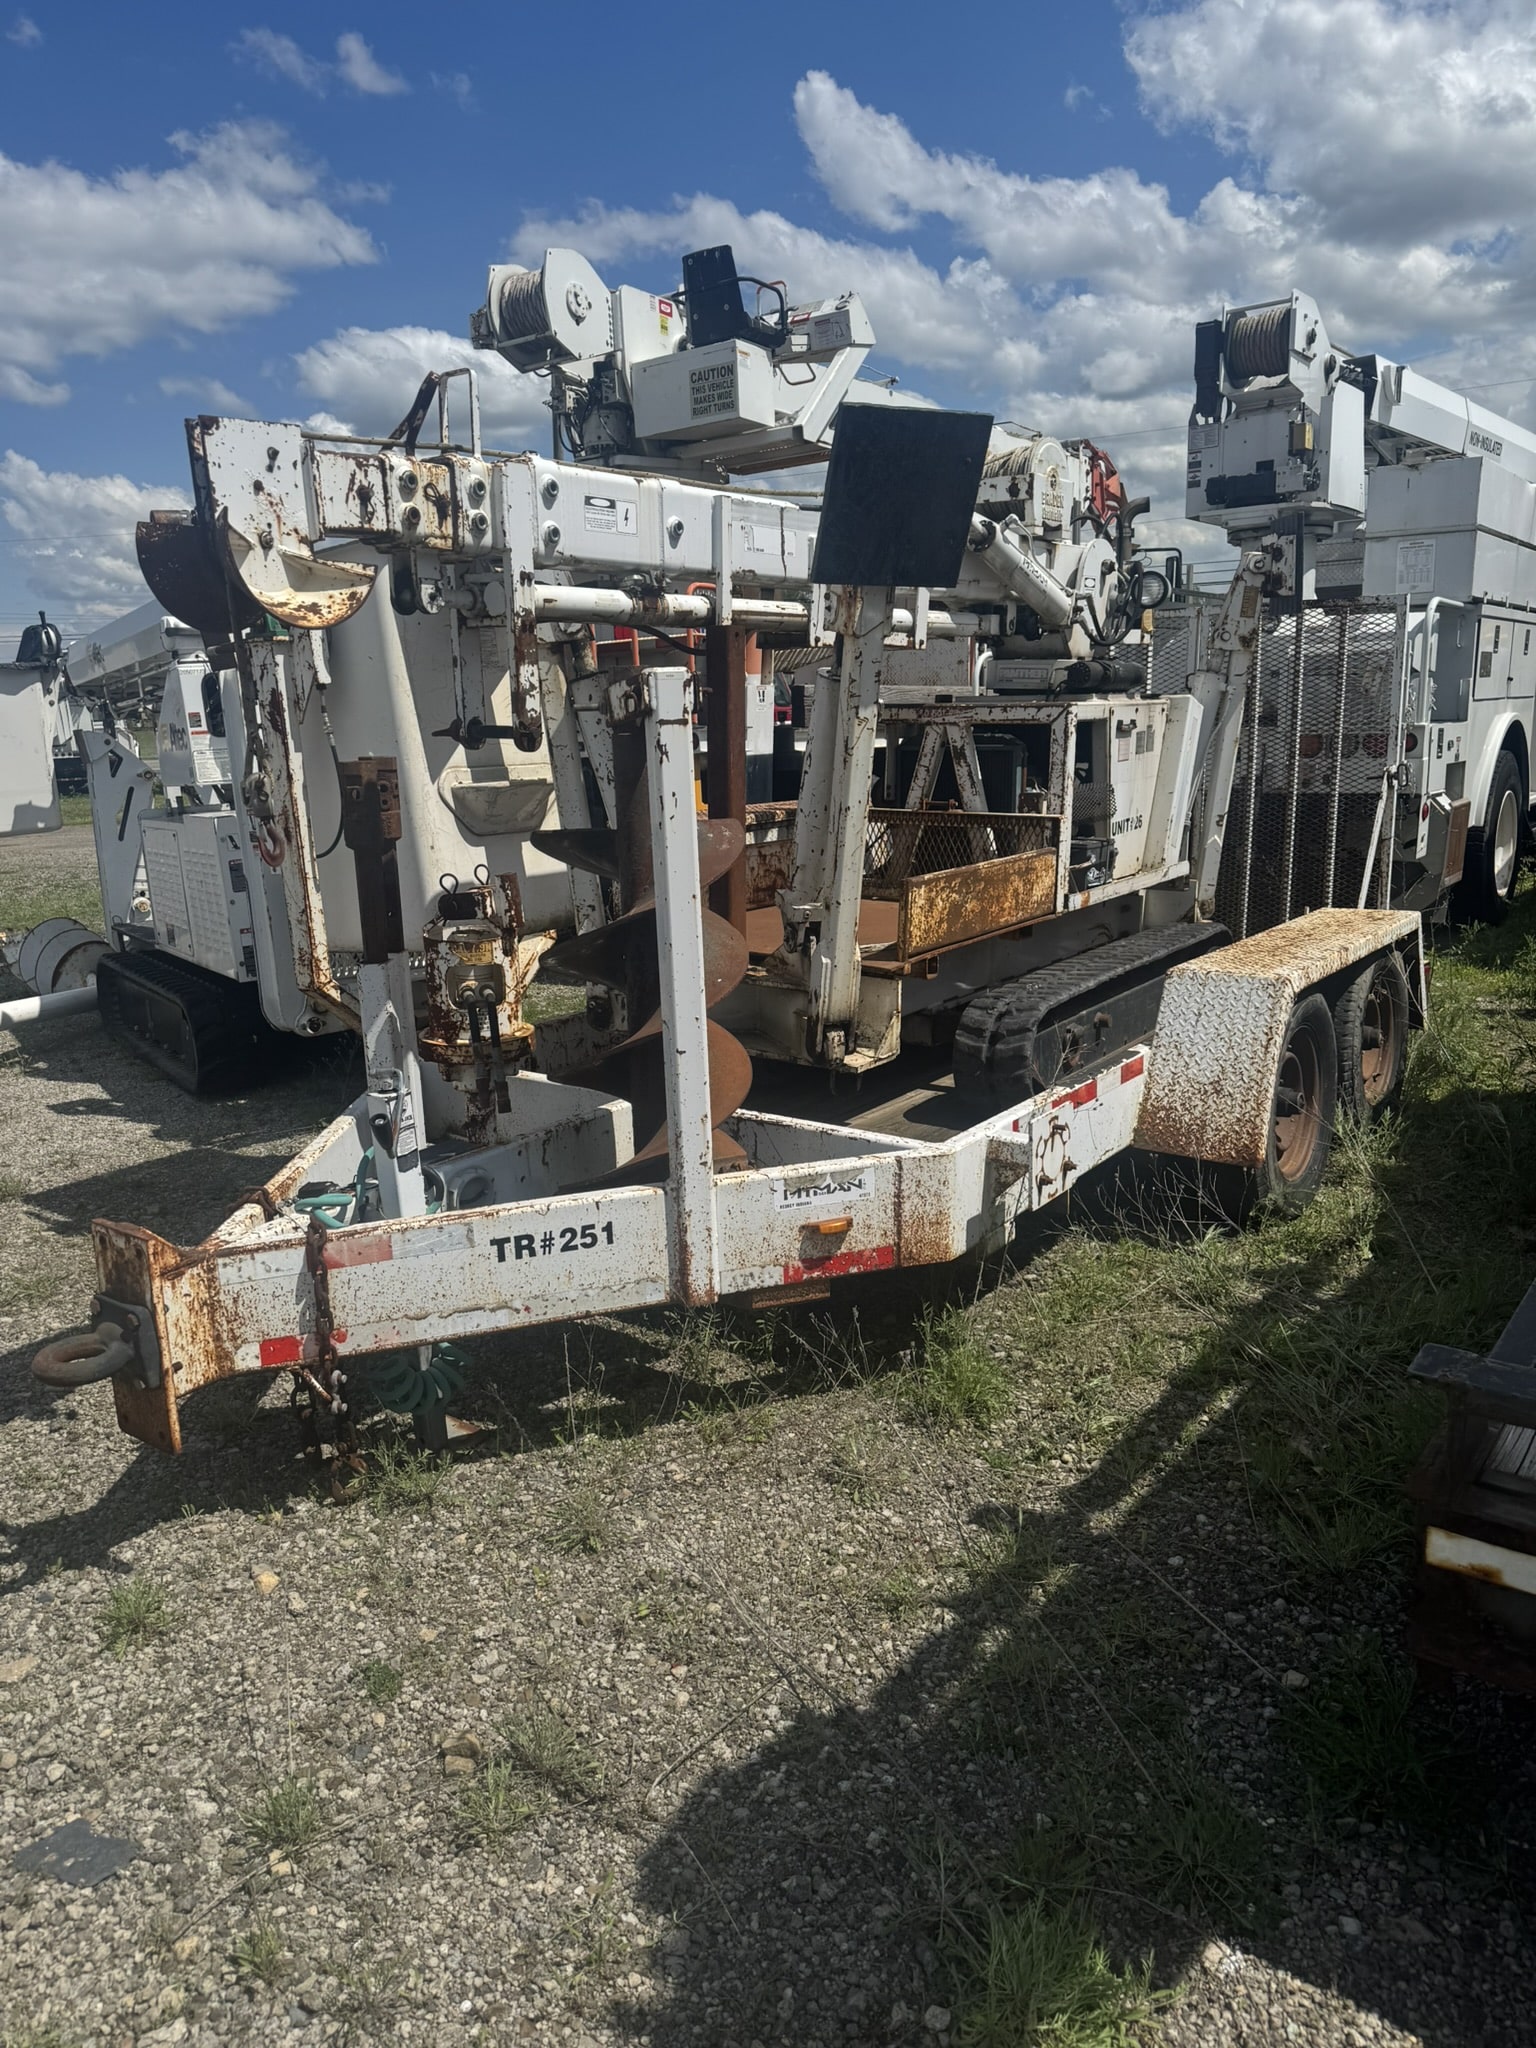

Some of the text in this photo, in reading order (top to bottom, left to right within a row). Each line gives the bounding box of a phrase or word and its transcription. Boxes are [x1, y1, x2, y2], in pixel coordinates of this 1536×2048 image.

[690, 363, 734, 384] CAUTION
[691, 378, 735, 396] THIS VEHICLE
[693, 389, 733, 406] MAKES WIDE
[692, 399, 735, 417] RIGHT TURNS
[1469, 430, 1503, 457] NON-INSULATED
[489, 1220, 615, 1263] TR#251
